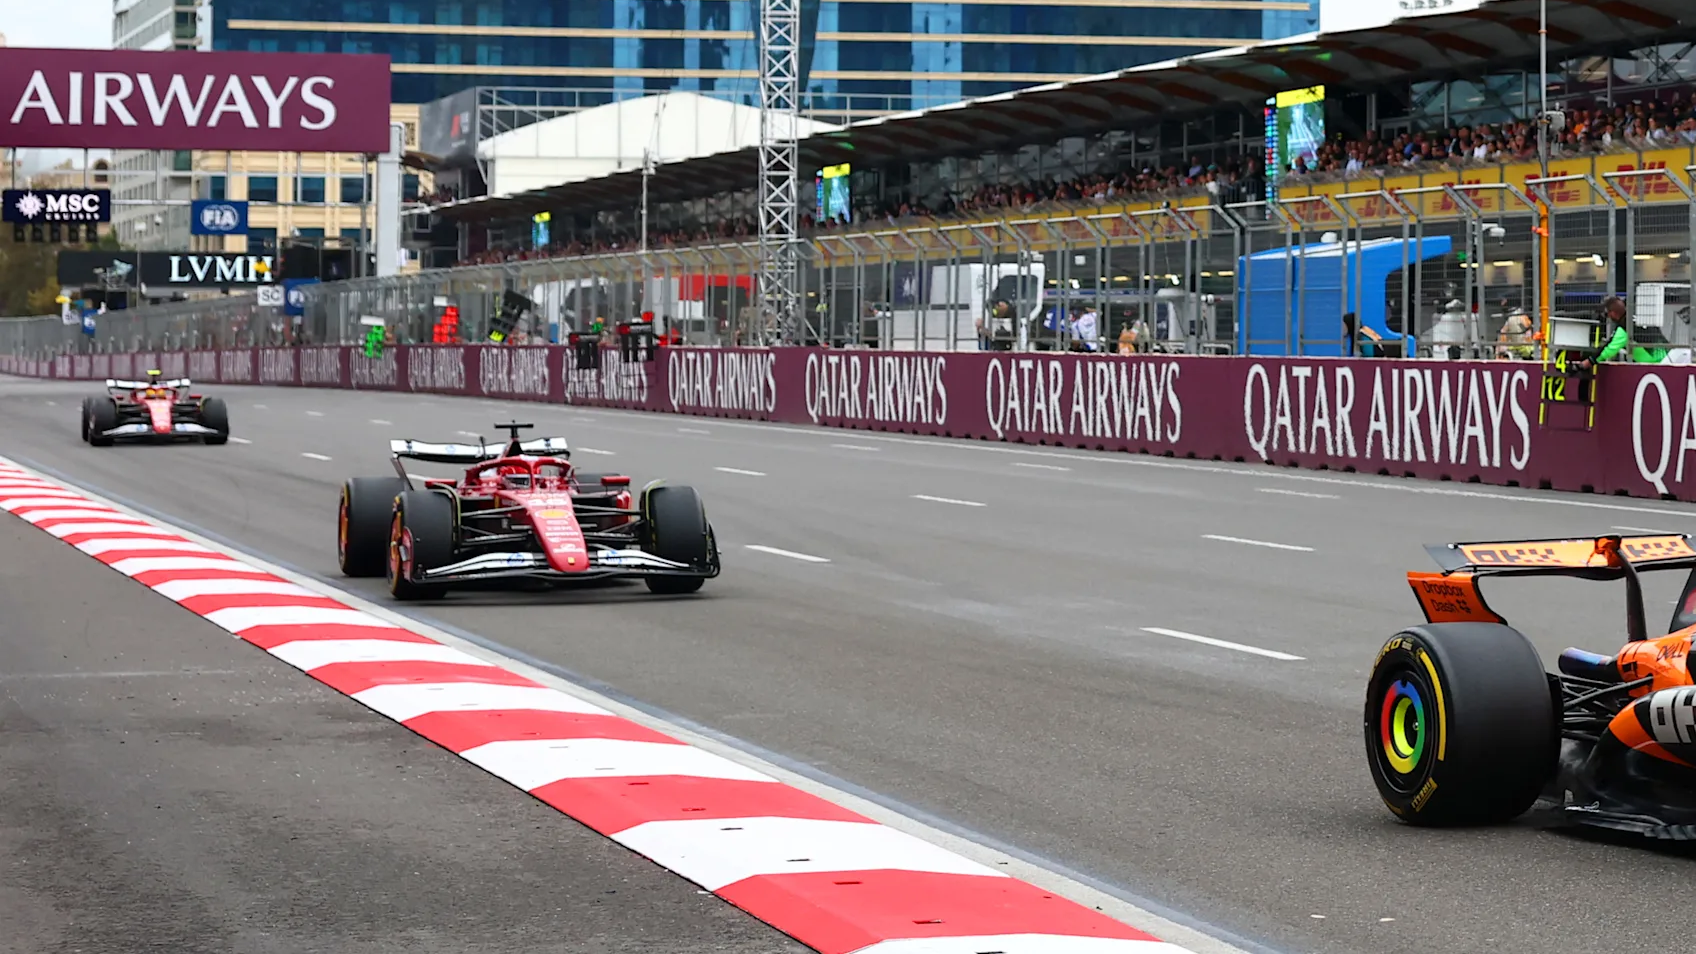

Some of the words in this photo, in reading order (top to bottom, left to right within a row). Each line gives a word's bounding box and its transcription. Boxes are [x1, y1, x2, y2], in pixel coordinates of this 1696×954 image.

[10, 69, 338, 131] AIRWAYS
[45, 193, 101, 213] MSC
[203, 209, 235, 227] FIA
[169, 254, 275, 283] LVMH
[261, 288, 281, 302] SC
[1555, 349, 1568, 374] 4
[668, 351, 712, 413] QATAR
[714, 352, 776, 414] AIRWAYS
[805, 353, 863, 424] QATAR
[865, 355, 947, 426] AIRWAYS
[1545, 376, 1566, 401] 12
[985, 357, 1065, 438] QATAR
[1070, 360, 1183, 444] AIRWAYS
[1243, 362, 1358, 461] QATAR
[1365, 365, 1531, 471] AIRWAYS
[1422, 580, 1465, 598] Dropbox
[1431, 598, 1460, 614] Dash
[1656, 641, 1685, 661] DELL
